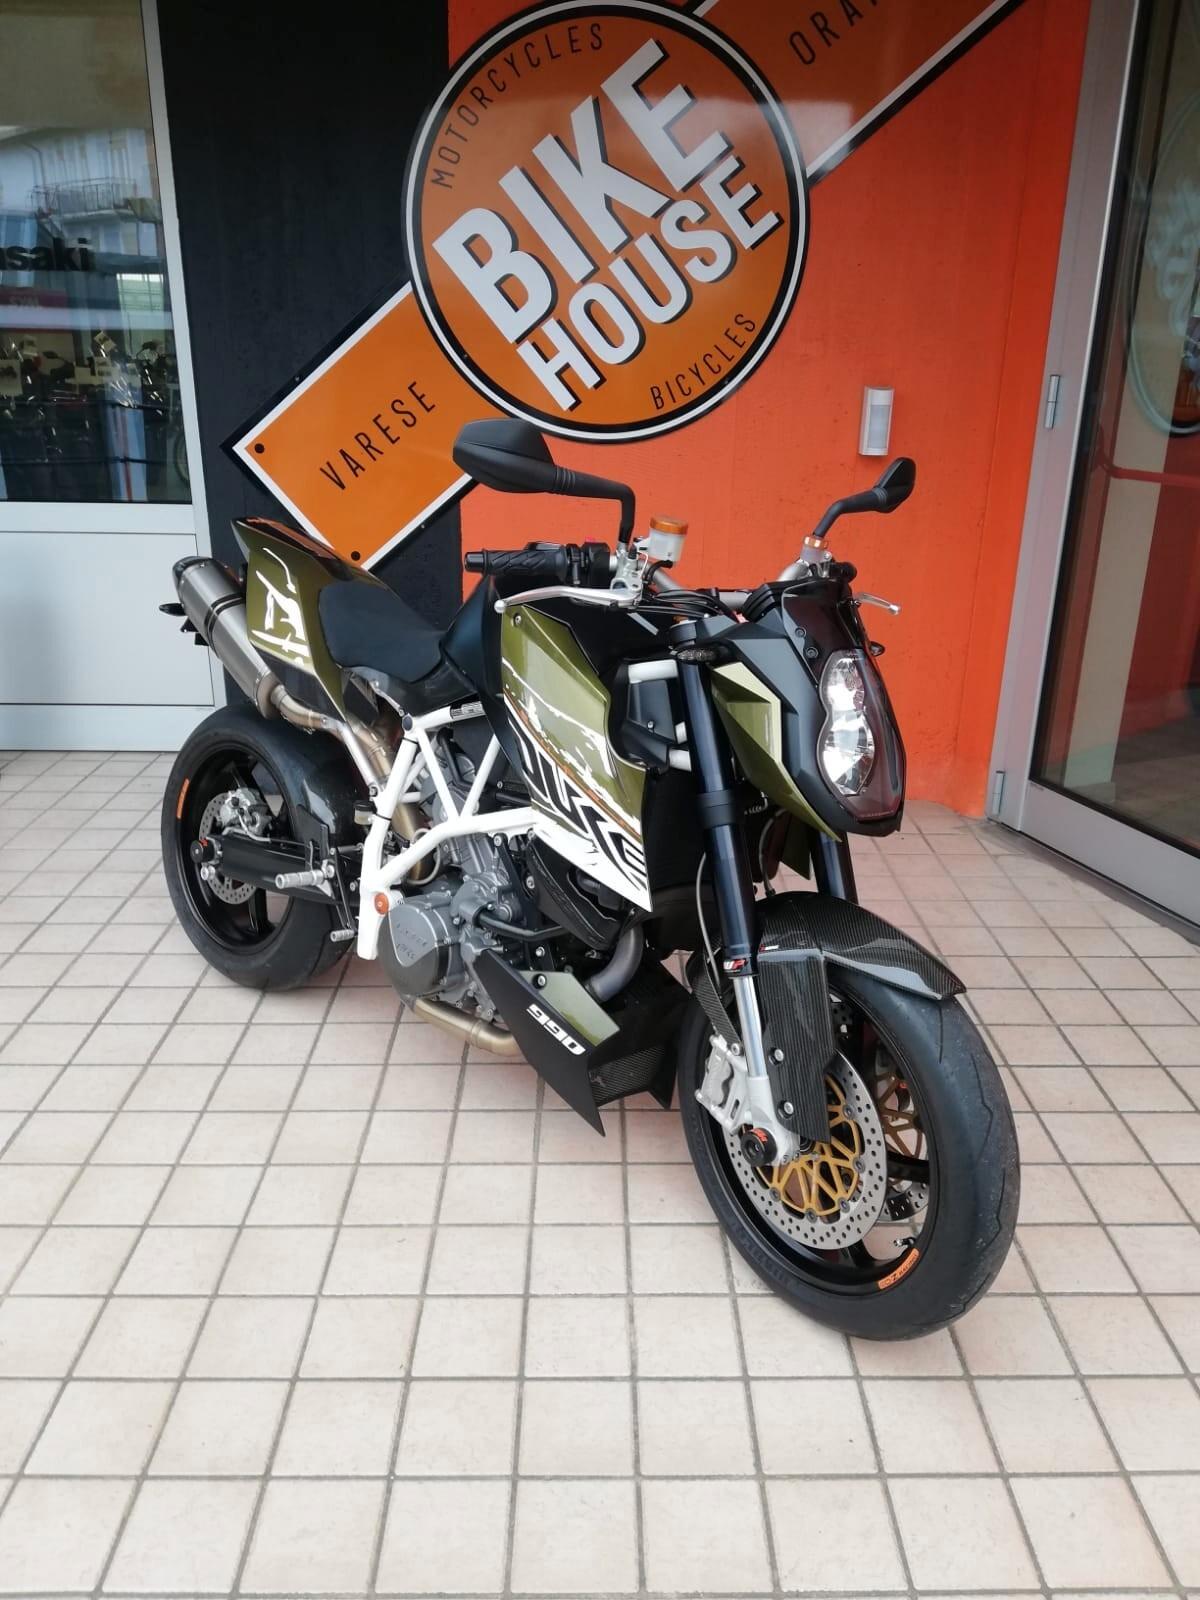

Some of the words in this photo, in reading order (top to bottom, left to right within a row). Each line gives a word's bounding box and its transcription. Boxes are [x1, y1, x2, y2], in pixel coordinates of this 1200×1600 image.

[788, 0, 878, 65] ORA
[431, 22, 603, 189] MOTORCYCLES
[432, 37, 733, 345] BIKE
[0, 237, 89, 272] saki
[516, 154, 784, 412] HOUSE
[649, 313, 756, 410] BICYCLES
[319, 381, 436, 491] VARESE
[526, 1003, 587, 1056] 990
